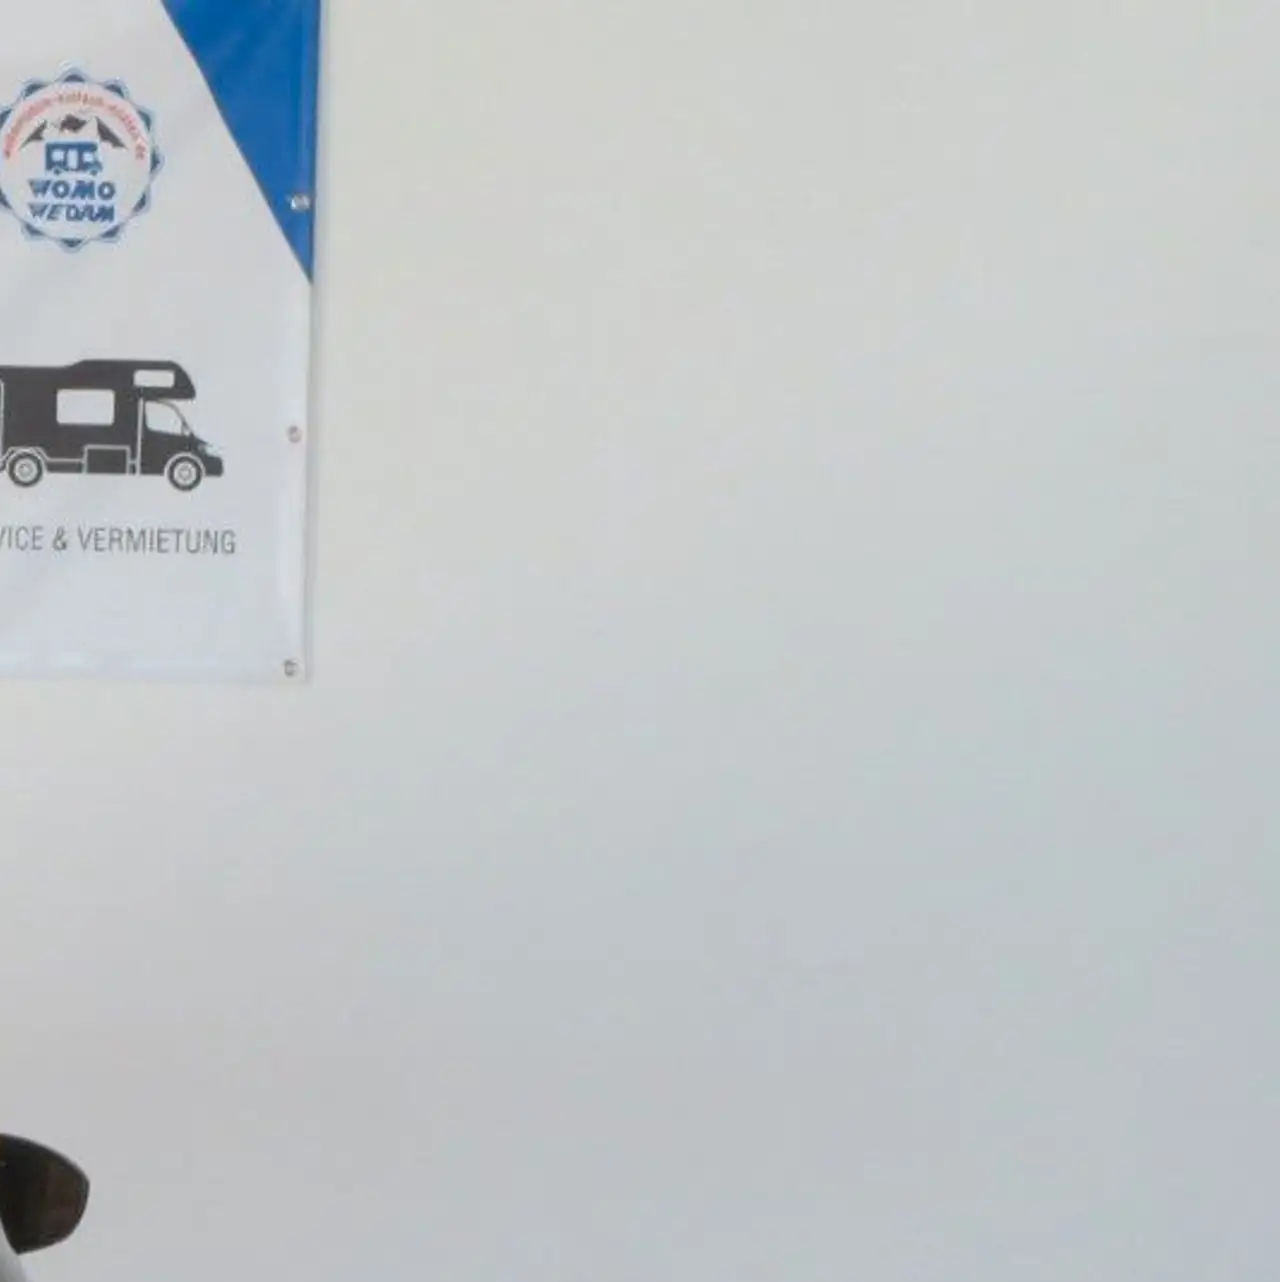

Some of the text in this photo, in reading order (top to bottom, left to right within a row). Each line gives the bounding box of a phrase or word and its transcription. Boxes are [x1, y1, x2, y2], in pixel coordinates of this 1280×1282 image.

[29, 180, 116, 200] WOMO
[52, 527, 69, 552] &
[78, 527, 236, 555] VERMIETUNG
